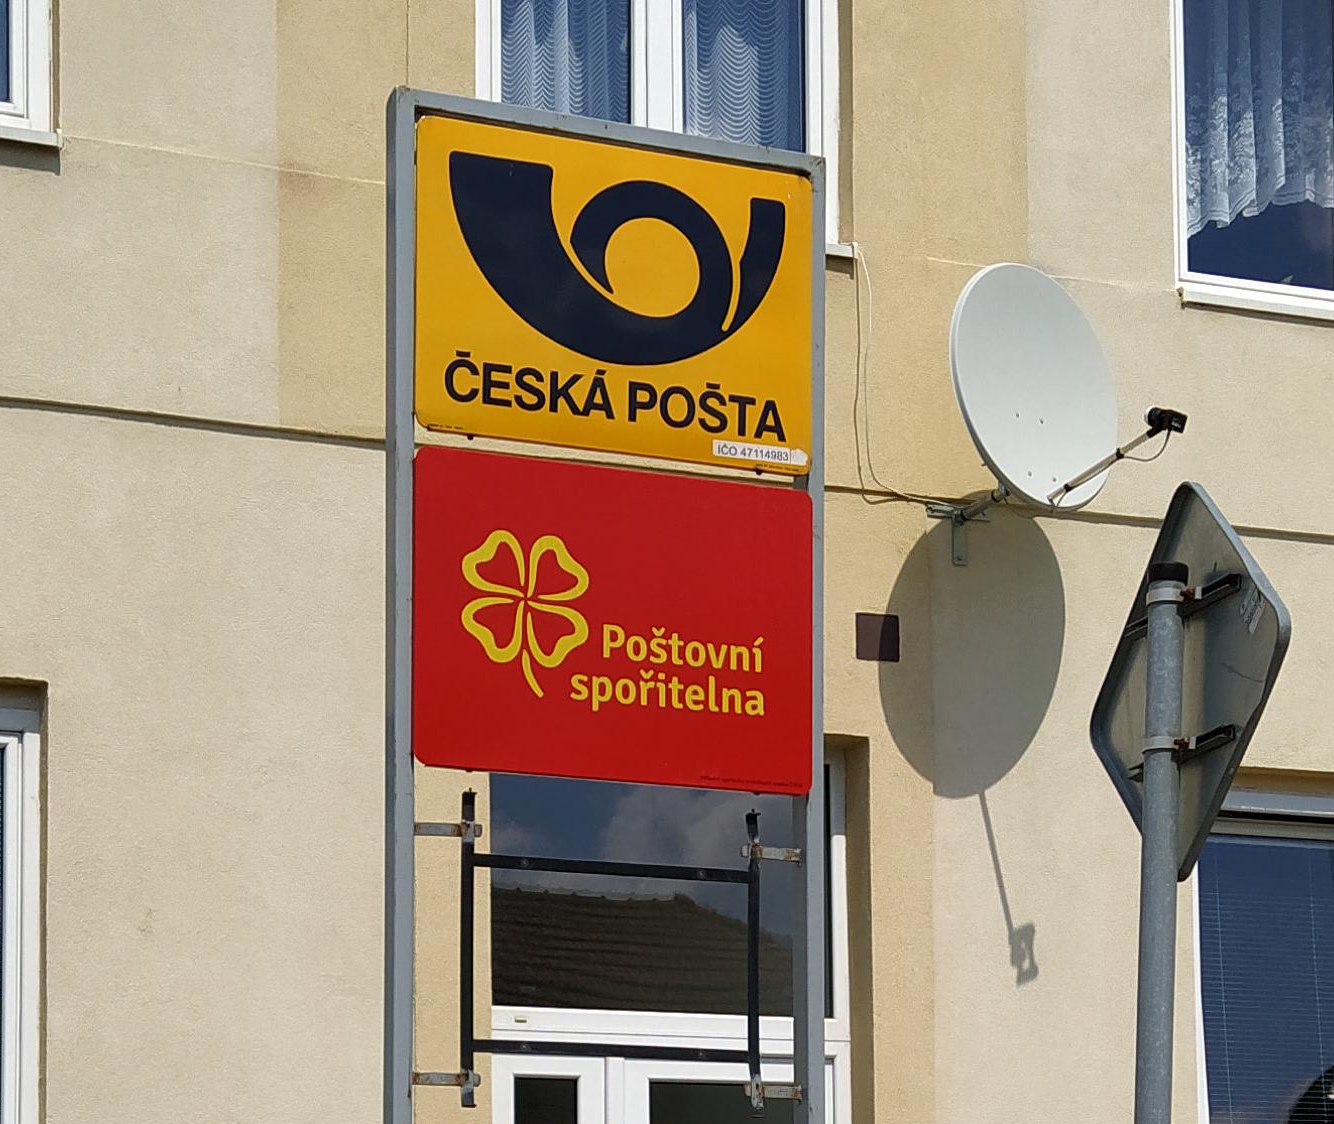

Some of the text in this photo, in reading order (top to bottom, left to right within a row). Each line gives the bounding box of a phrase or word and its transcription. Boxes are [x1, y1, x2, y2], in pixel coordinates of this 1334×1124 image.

[444, 350, 787, 442] ČESKÁ POŠTA
[717, 443, 789, 461] IČO 47114983
[602, 623, 764, 673] Poštovní
[570, 669, 765, 717] spořitelna
